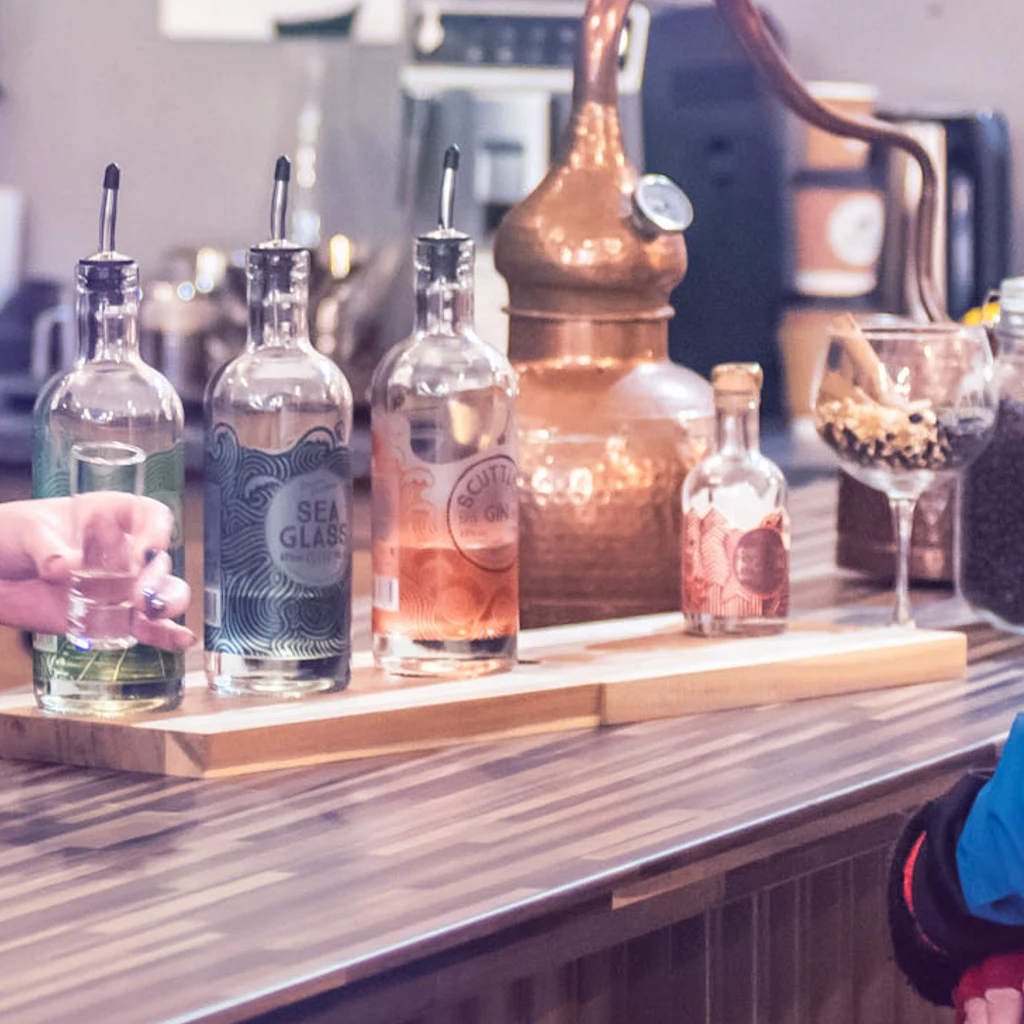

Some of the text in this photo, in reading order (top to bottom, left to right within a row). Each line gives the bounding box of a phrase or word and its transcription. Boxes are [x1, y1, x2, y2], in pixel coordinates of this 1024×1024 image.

[296, 499, 340, 524] SEA
[483, 501, 509, 524] GIN
[279, 522, 347, 549] GLASS
